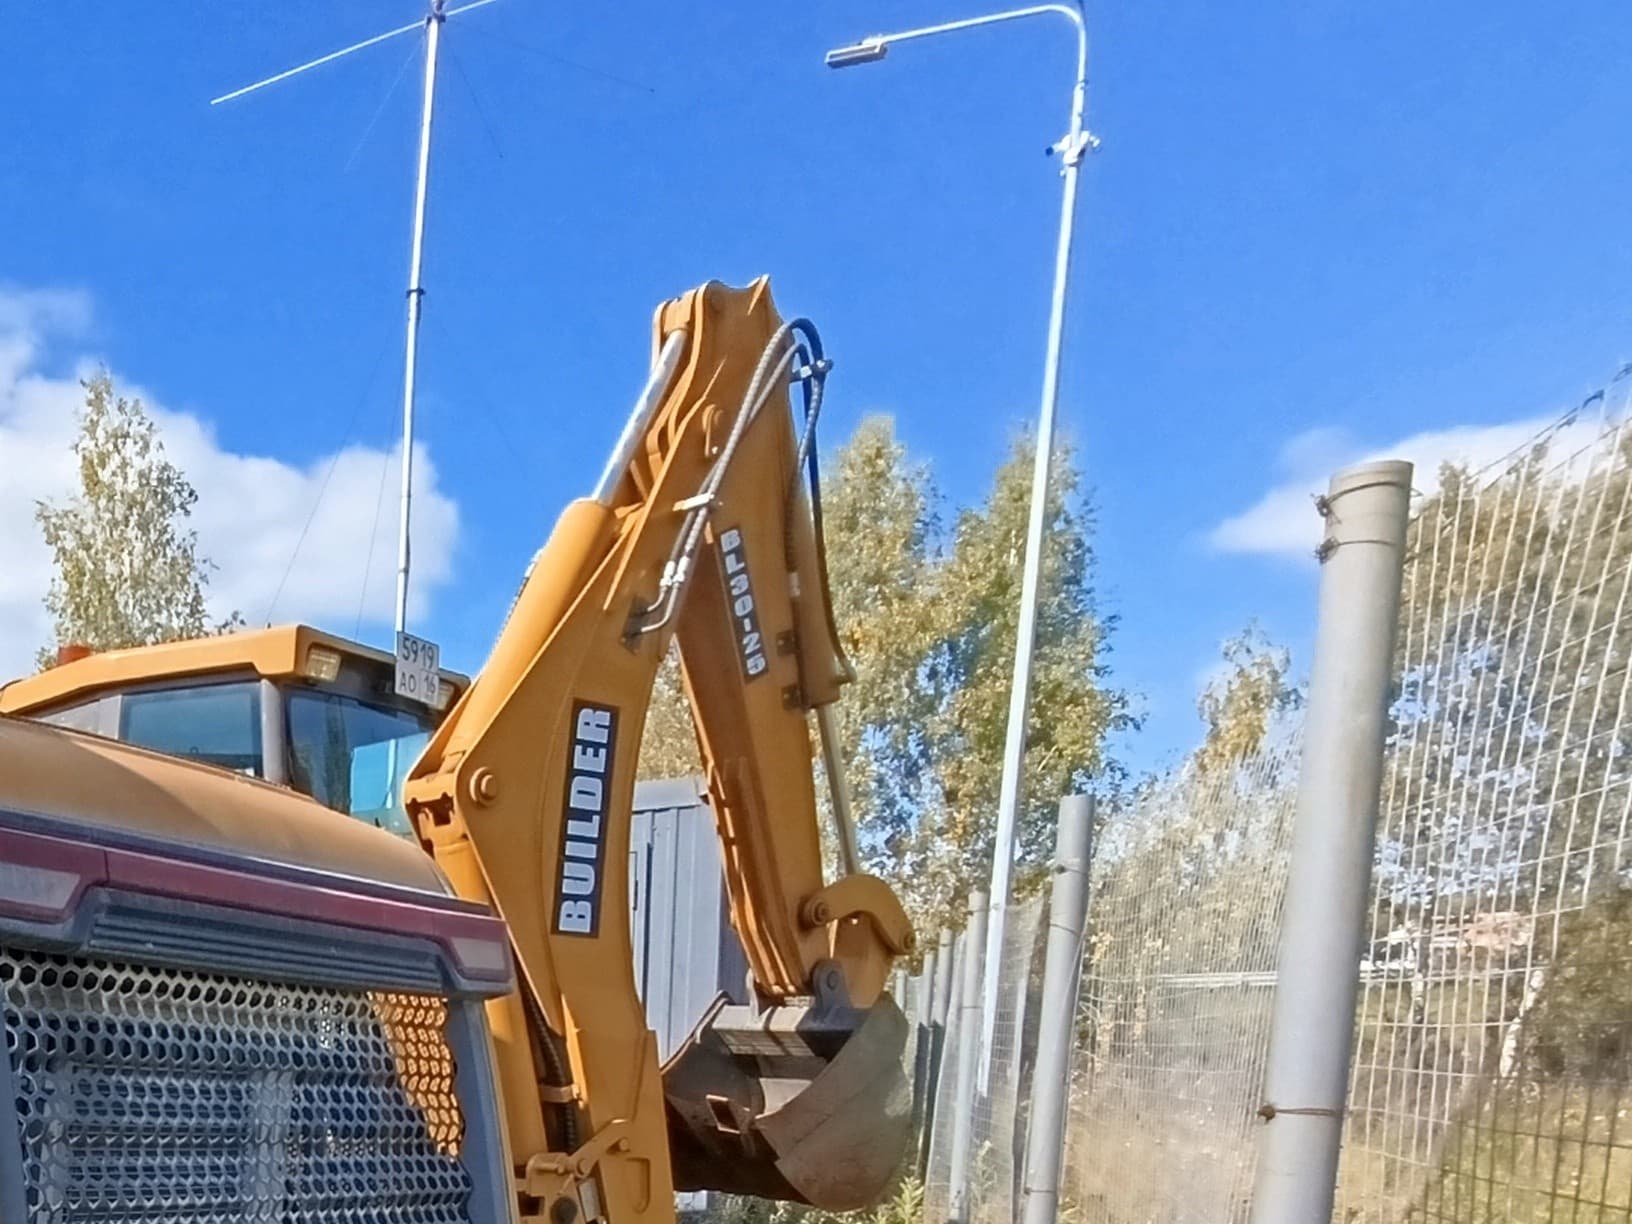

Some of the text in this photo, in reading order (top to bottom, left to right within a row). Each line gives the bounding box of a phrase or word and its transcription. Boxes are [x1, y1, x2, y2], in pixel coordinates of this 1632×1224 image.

[401, 636, 435, 669] 5919
[720, 529, 766, 676] BL30-25
[558, 707, 611, 933] BUILDER
